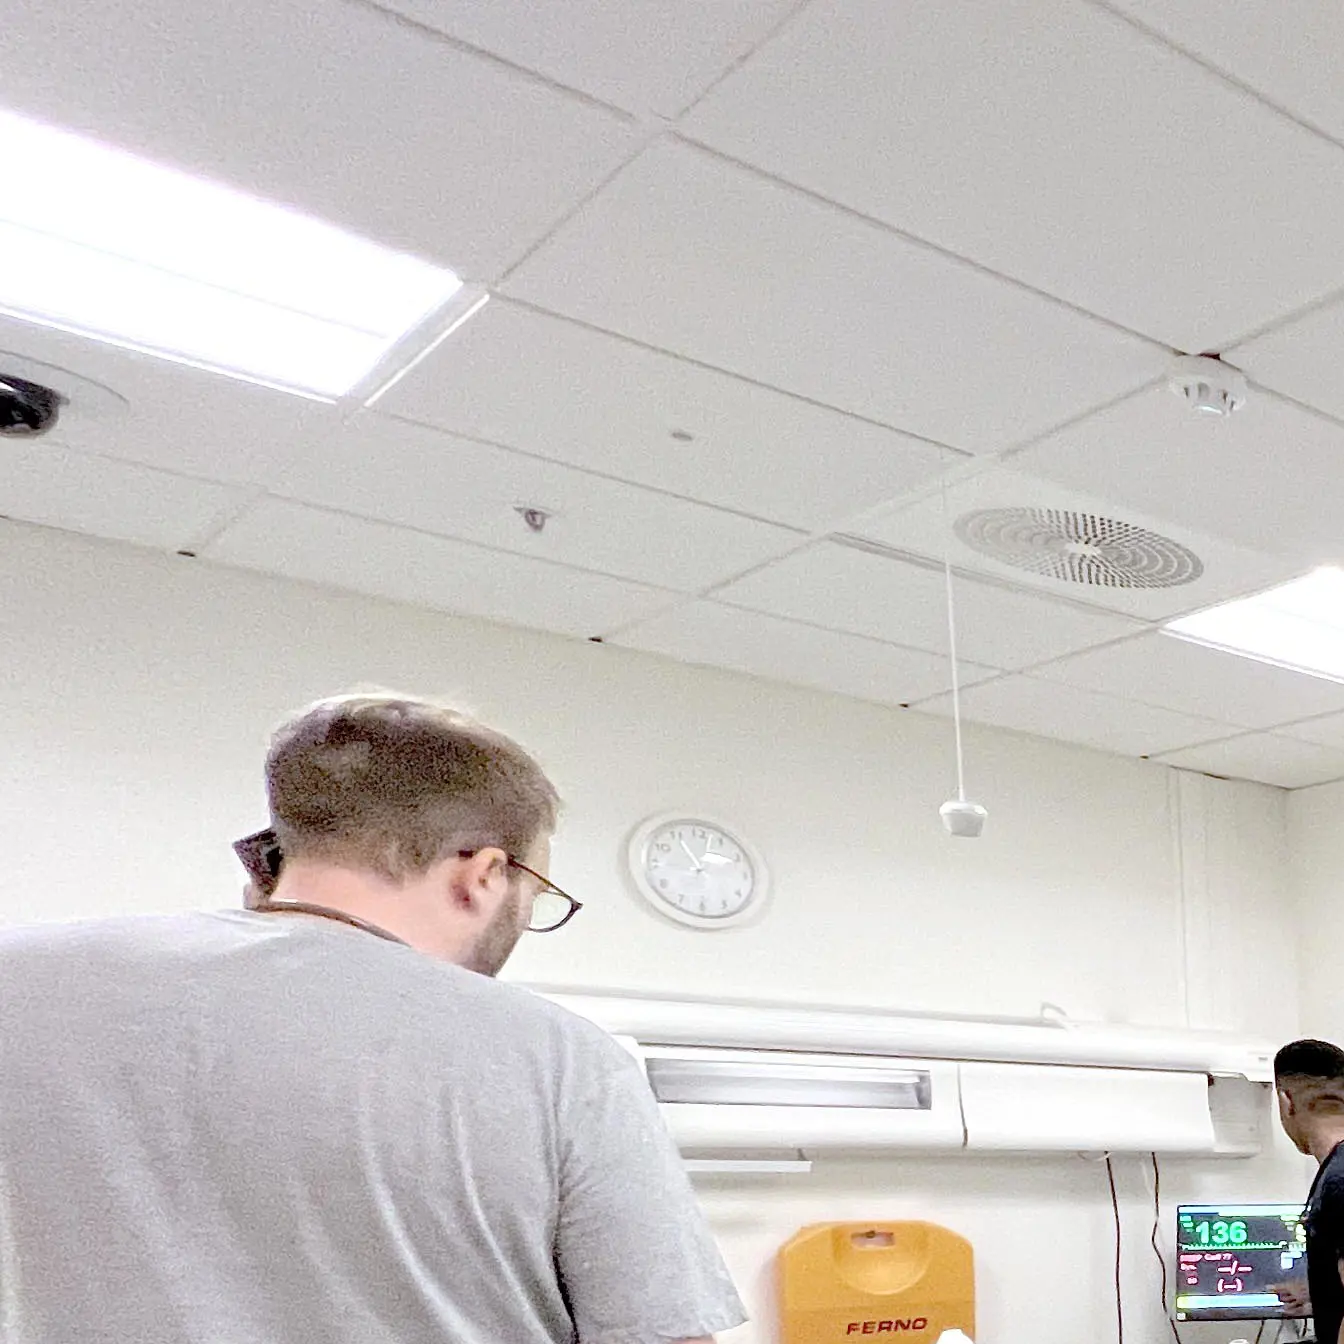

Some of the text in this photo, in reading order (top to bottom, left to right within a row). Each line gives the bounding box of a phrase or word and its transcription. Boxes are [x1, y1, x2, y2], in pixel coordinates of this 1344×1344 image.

[655, 843, 671, 853] 10
[1195, 1220, 1248, 1244] 136
[846, 1317, 928, 1336] FERNO
